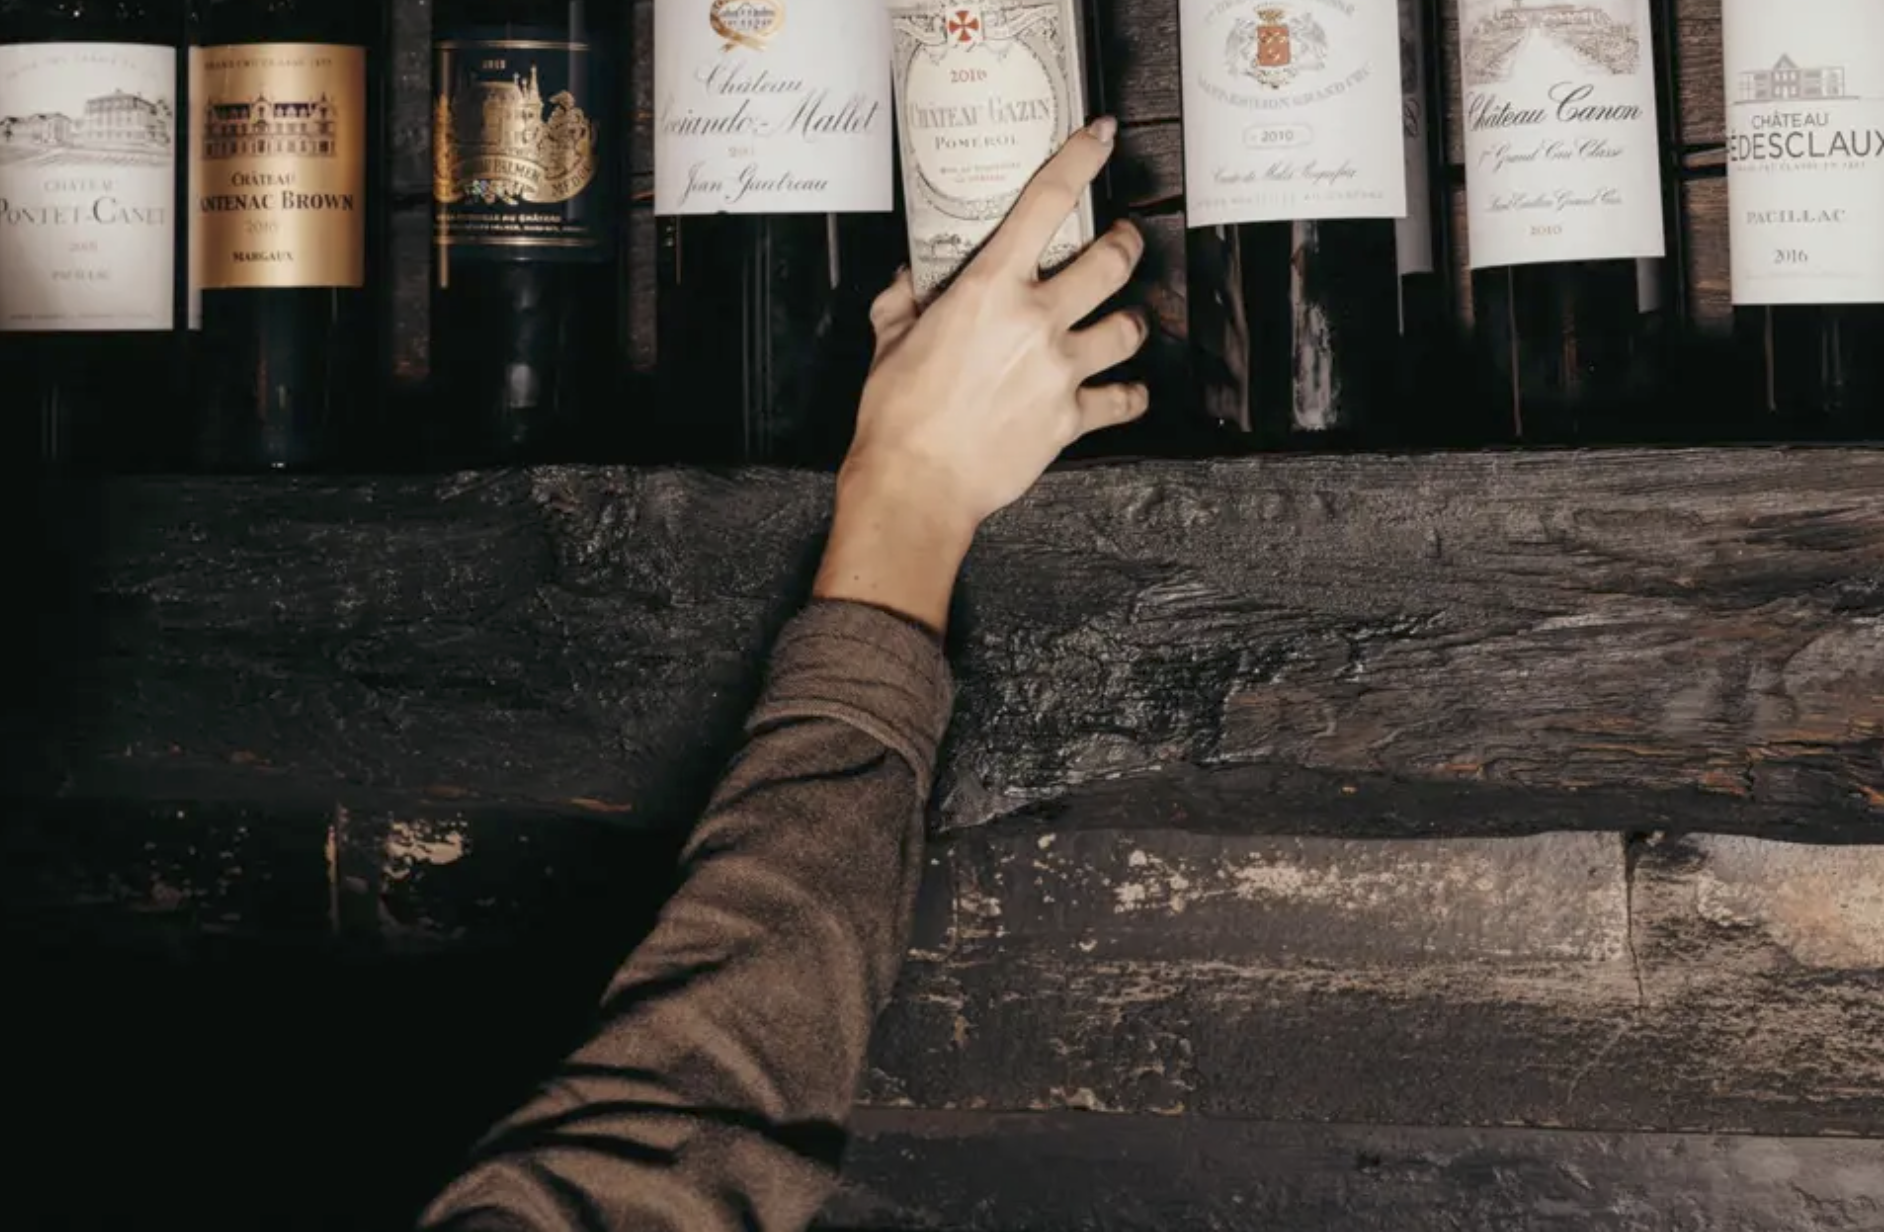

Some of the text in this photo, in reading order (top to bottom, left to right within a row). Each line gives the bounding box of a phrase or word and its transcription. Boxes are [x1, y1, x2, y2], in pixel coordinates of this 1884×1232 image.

[1468, 90, 1548, 132] Château
[1548, 81, 1643, 123] Canon
[1751, 111, 1831, 130] CHÂTEAU
[934, 134, 1017, 150] POMEROL
[1260, 130, 1294, 143] 2010
[281, 189, 354, 212] BROWN
[232, 251, 294, 262] MARGAUX
[1772, 249, 1809, 265] 2016
